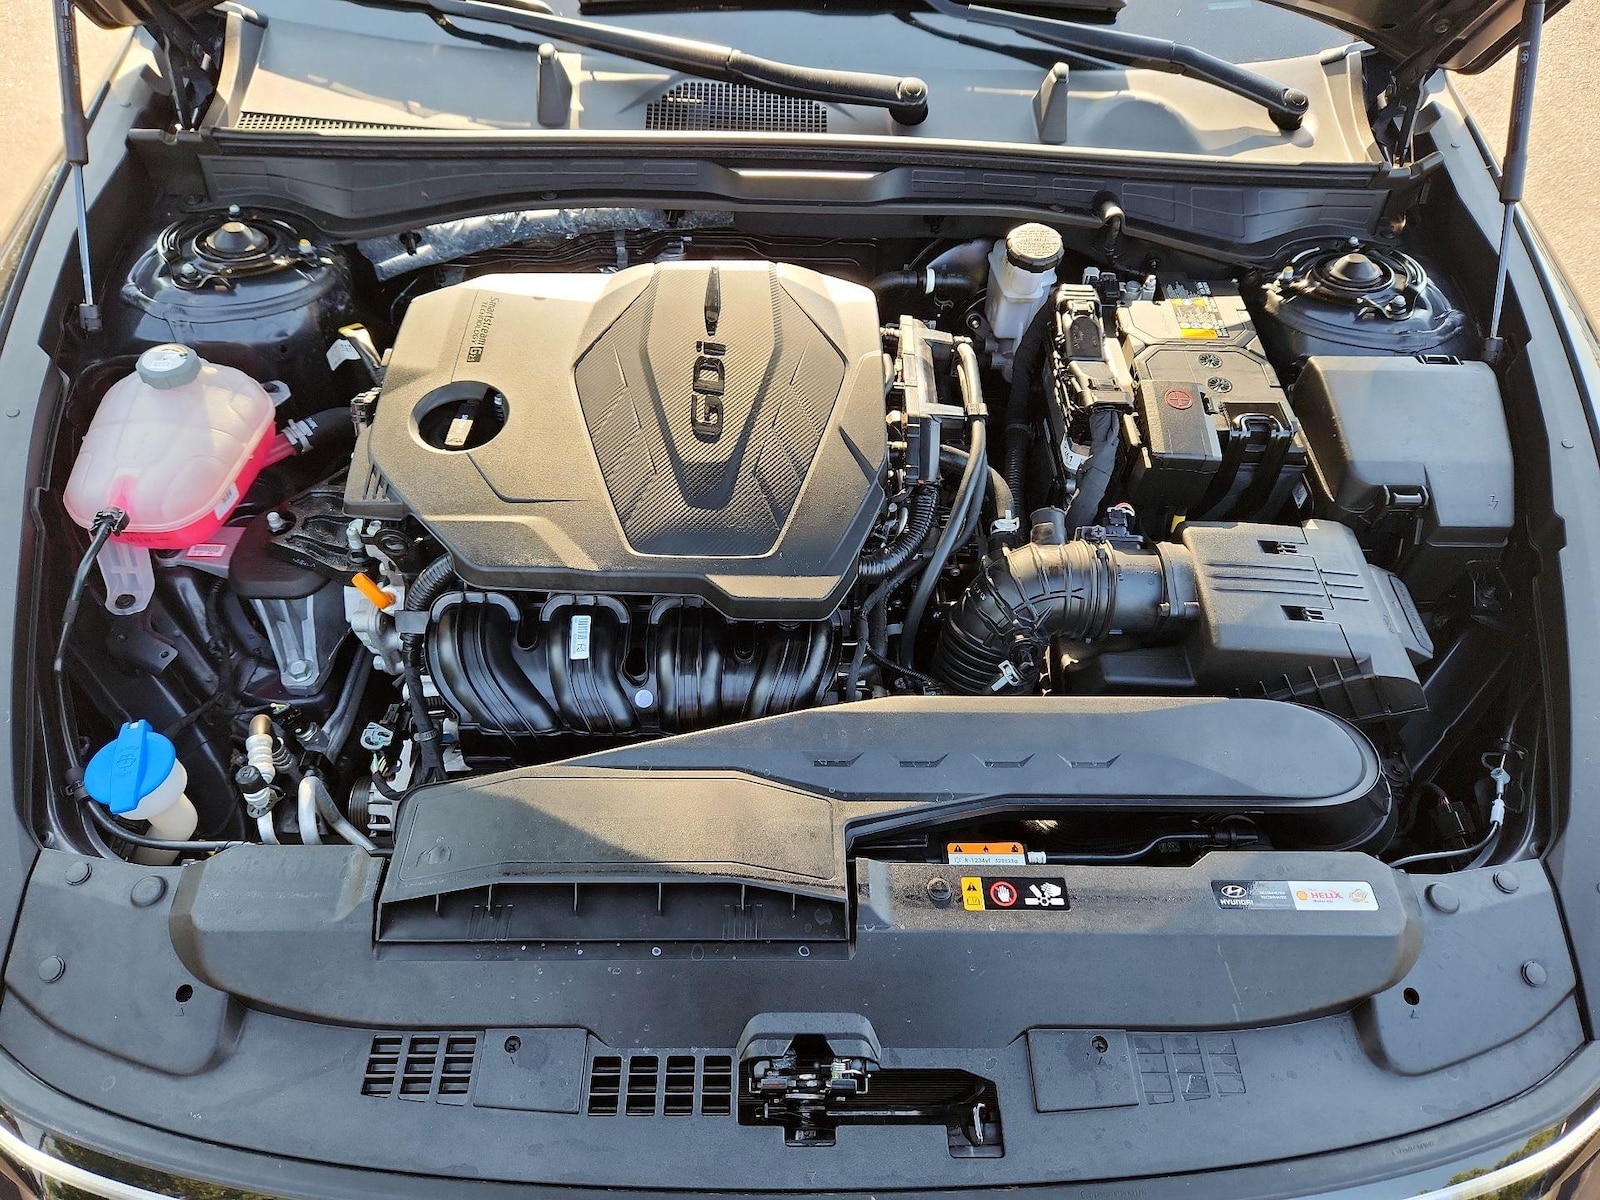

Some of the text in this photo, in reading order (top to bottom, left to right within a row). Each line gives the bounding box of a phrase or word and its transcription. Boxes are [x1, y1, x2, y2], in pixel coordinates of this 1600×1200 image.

[472, 301, 489, 346] TECHNOLOGY
[478, 297, 500, 346] Smartstream
[691, 341, 727, 443] GDi
[1219, 898, 1255, 906] HYUNDAI
[1311, 891, 1343, 899] HELIX
